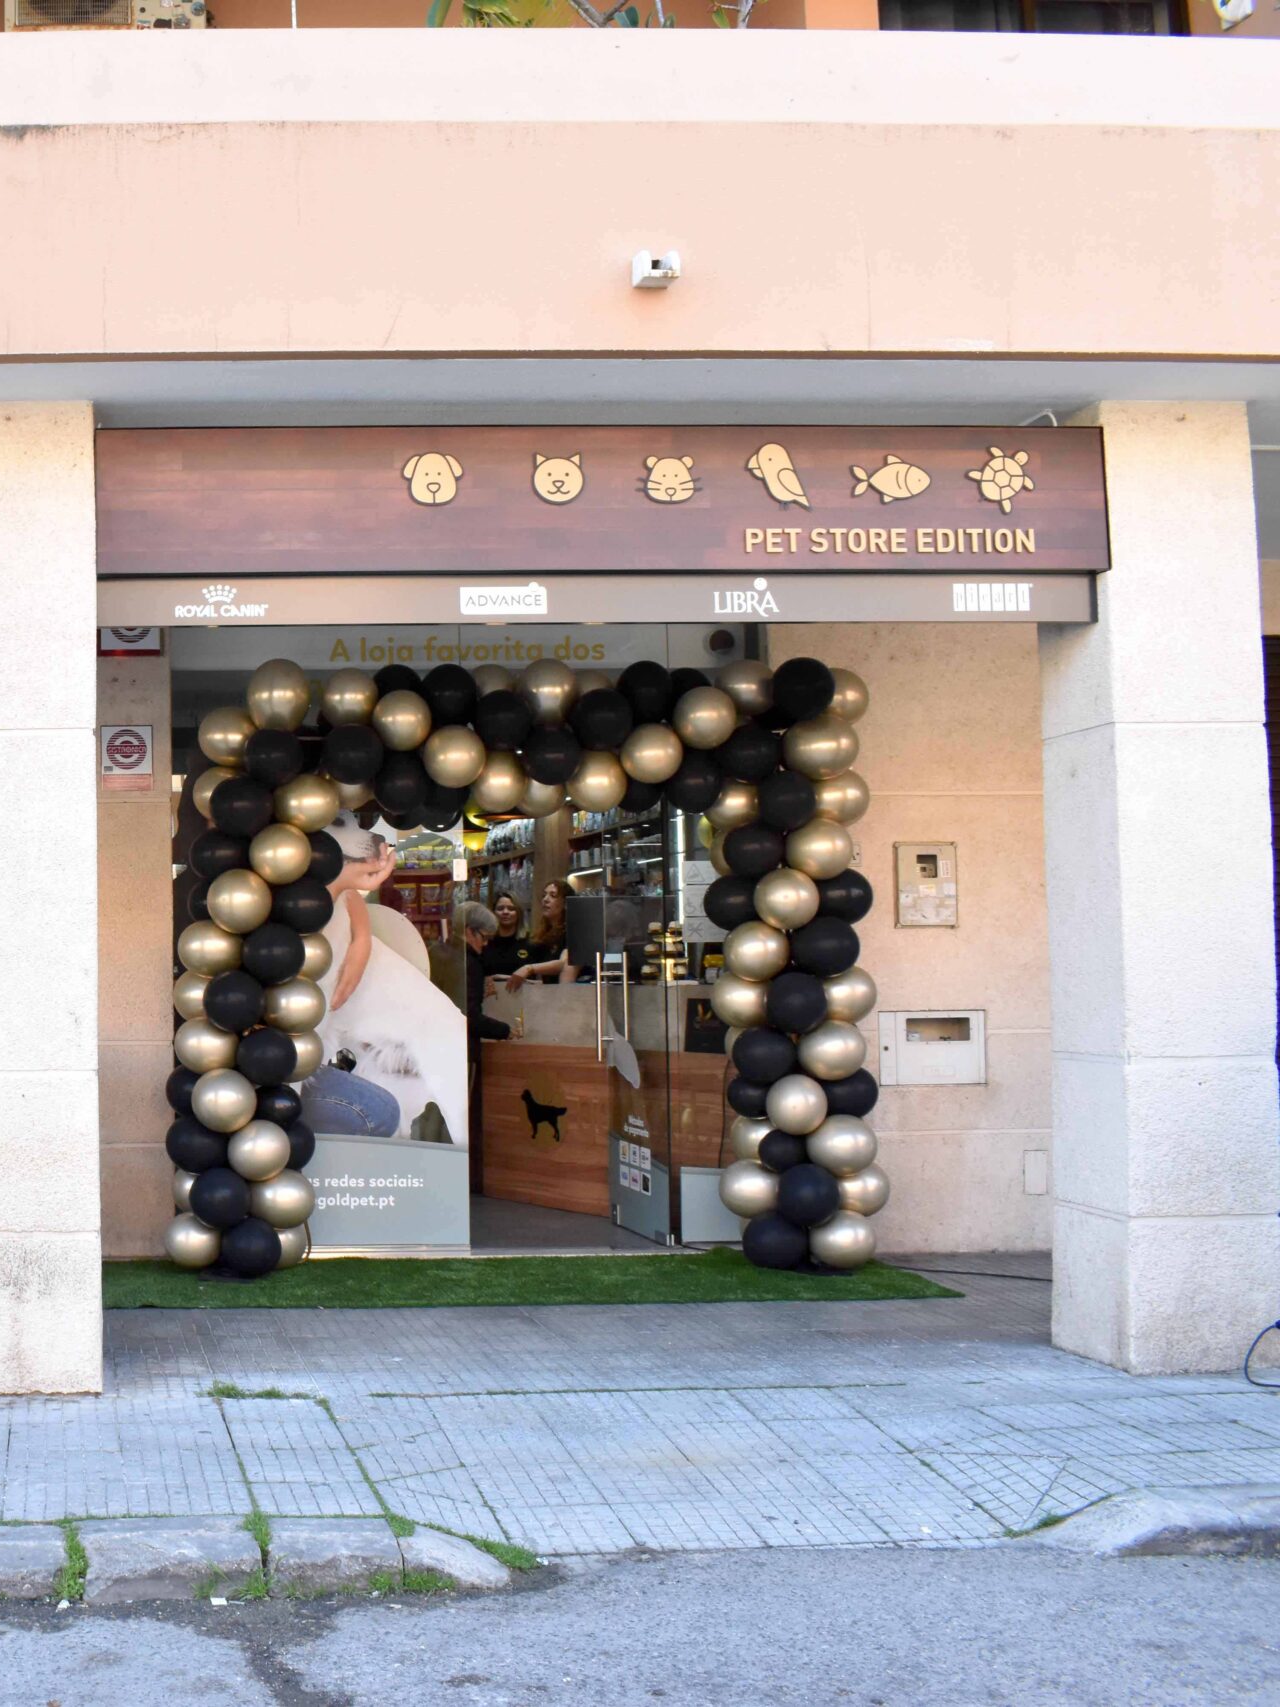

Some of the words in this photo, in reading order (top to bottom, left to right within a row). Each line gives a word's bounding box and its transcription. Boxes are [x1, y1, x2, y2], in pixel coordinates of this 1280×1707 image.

[745, 528, 802, 554] PET
[809, 528, 908, 554] STORE
[917, 528, 1036, 554] EDITION
[465, 594, 543, 607] ADVANCE
[713, 590, 780, 616] LIBRA
[174, 604, 218, 618] ROYAL
[220, 604, 266, 618] CANIN
[329, 638, 352, 663] A
[360, 636, 414, 664] loja
[423, 636, 543, 662] favorita
[553, 636, 606, 661] dos
[324, 1174, 365, 1188] redes
[369, 1174, 424, 1188] sociais:
[315, 1193, 396, 1210] goldpet.pt
